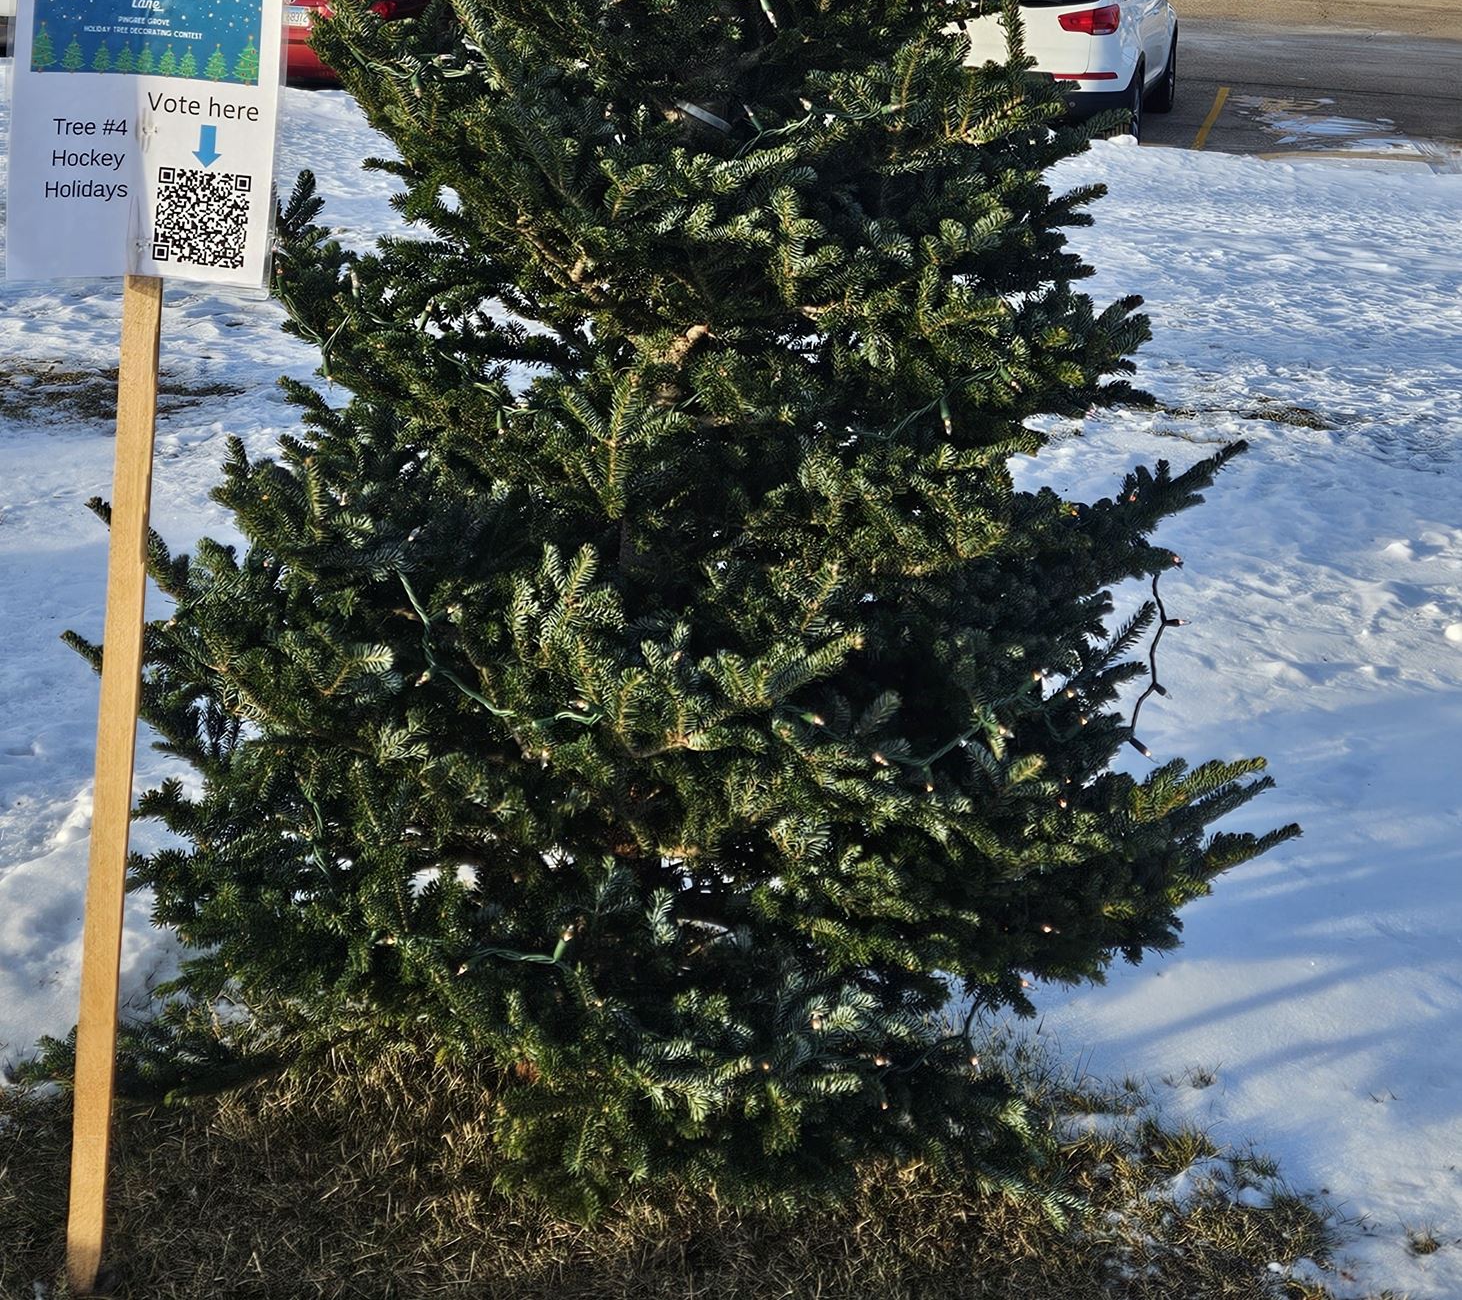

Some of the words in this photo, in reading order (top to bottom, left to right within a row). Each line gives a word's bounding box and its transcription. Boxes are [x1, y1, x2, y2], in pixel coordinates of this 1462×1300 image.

[118, 16, 145, 25] PINGREE
[147, 17, 170, 27] GROVE
[83, 25, 111, 33] HOLIDAY
[113, 26, 128, 34] TREE
[130, 27, 172, 37] DECORATING
[173, 30, 202, 39] CONTEST
[148, 92, 200, 115] Vote
[208, 97, 259, 121] here
[53, 118, 96, 135] Tree
[102, 119, 128, 136] #4
[52, 149, 125, 171] Hockey
[45, 180, 128, 202] Holidays
